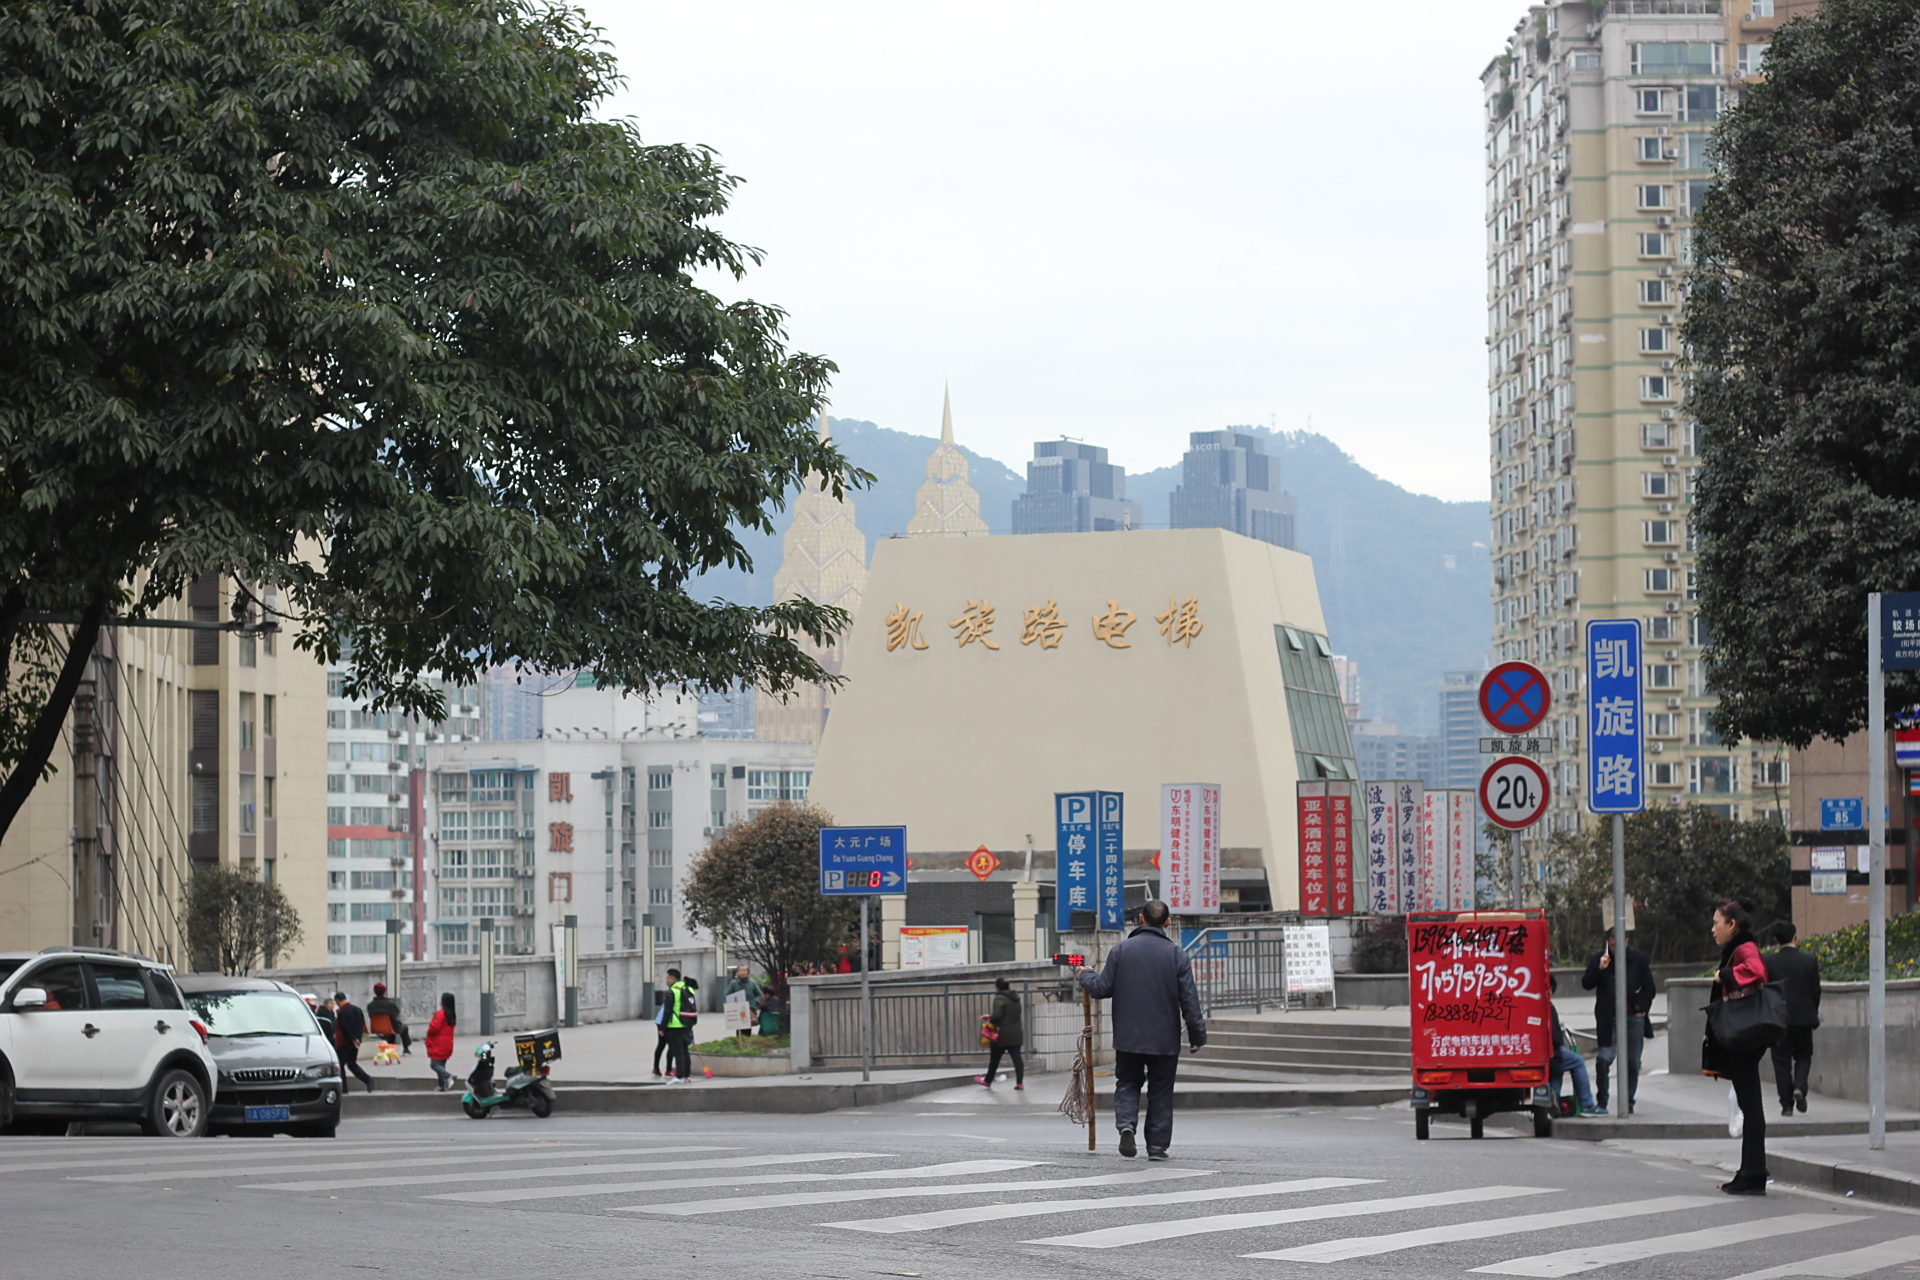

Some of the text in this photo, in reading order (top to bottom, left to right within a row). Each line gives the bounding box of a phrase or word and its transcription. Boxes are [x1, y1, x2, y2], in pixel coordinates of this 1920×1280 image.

[886, 596, 1204, 652] 凯旋路电梯
[1893, 609, 1920, 618] 轨道
[1594, 638, 1636, 795] 凯旋路
[1491, 739, 1540, 752] 凯旋路
[1496, 775, 1536, 809] 20t
[1068, 798, 1085, 822] P
[1105, 796, 1118, 821] P
[1835, 811, 1849, 823] 85
[834, 836, 891, 848] 大元广场
[1304, 800, 1324, 894] 亚朵酒店停车位
[1334, 799, 1348, 893] 亚朵酒店停车位
[1368, 785, 1387, 911] 波罗的海酒店
[1400, 785, 1416, 911] 波罗的海酒店
[857, 855, 875, 864] Guang
[875, 854, 894, 863] Chang
[1067, 834, 1087, 906] 停车库
[1104, 833, 1118, 908] 二十四小时停车
[828, 872, 841, 888] P
[1431, 1044, 1532, 1057] 188 8323 1255
